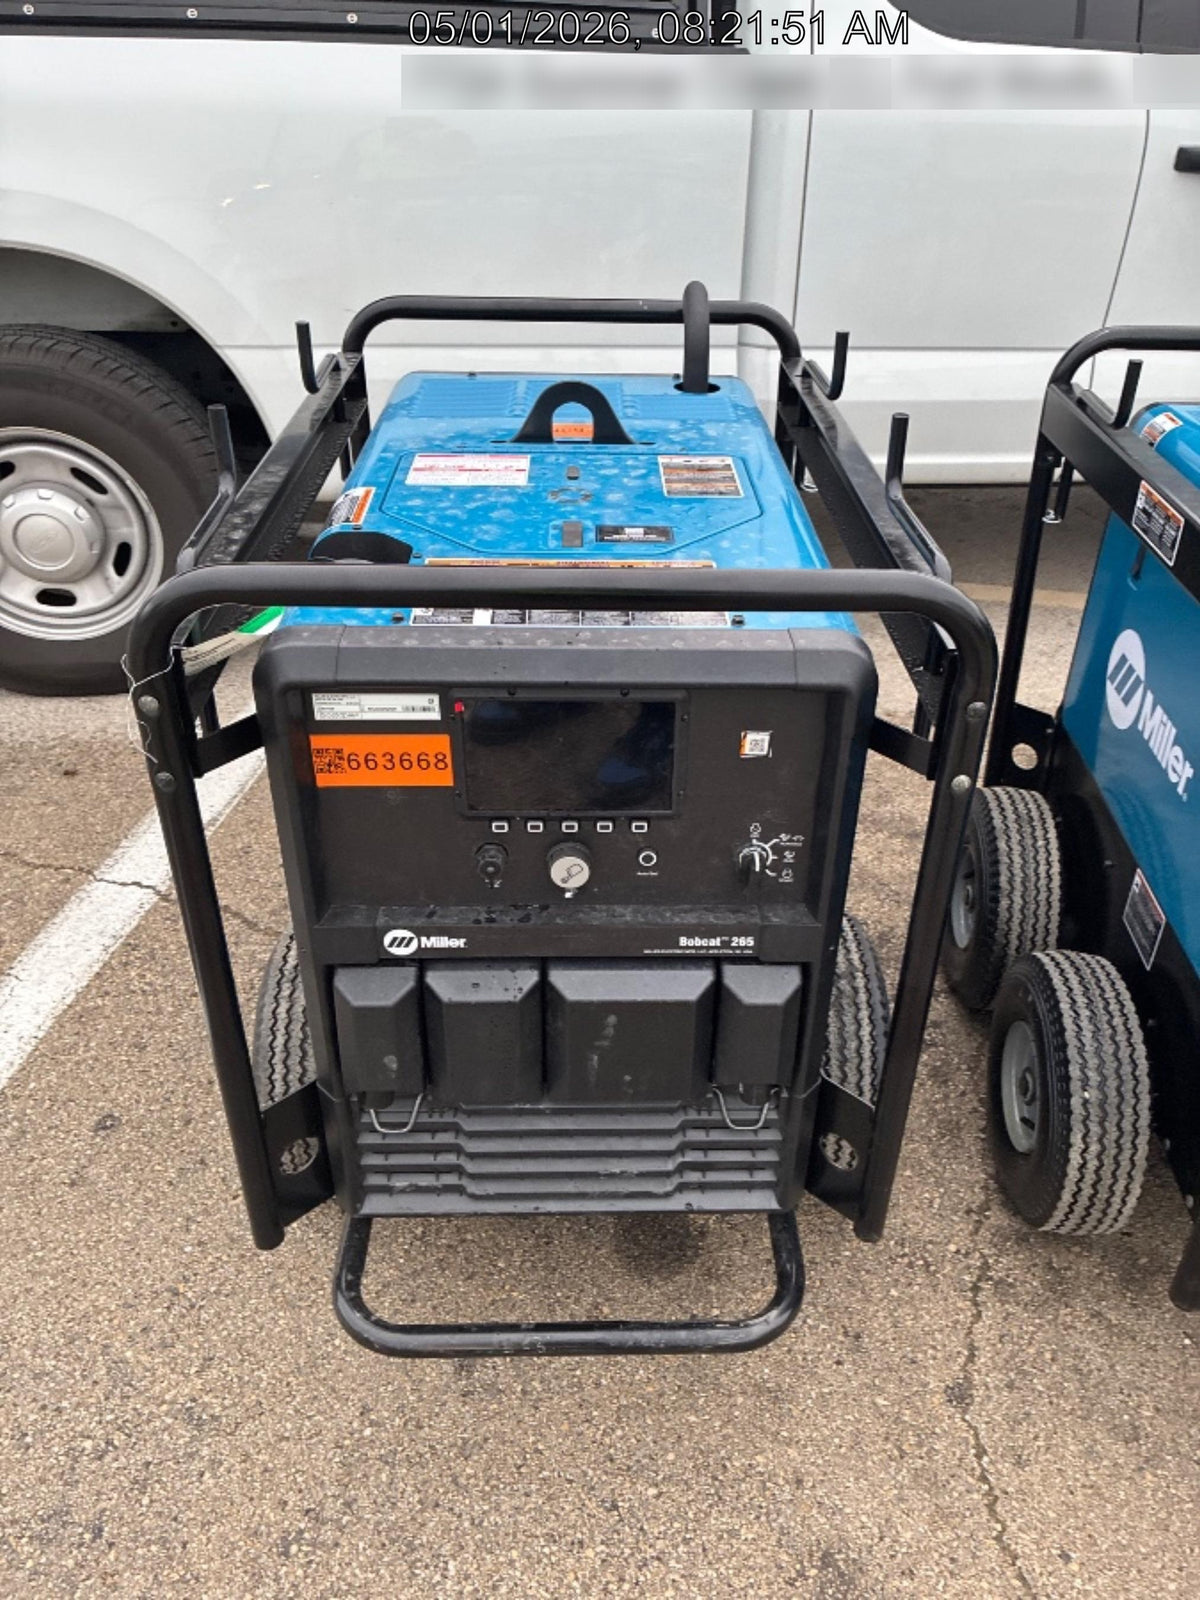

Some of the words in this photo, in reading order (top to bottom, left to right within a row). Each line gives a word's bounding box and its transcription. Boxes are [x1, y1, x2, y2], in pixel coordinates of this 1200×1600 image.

[1137, 689, 1194, 796] Miller
[346, 751, 449, 771] 663668
[420, 936, 467, 949] Miller
[730, 936, 755, 947] 265
